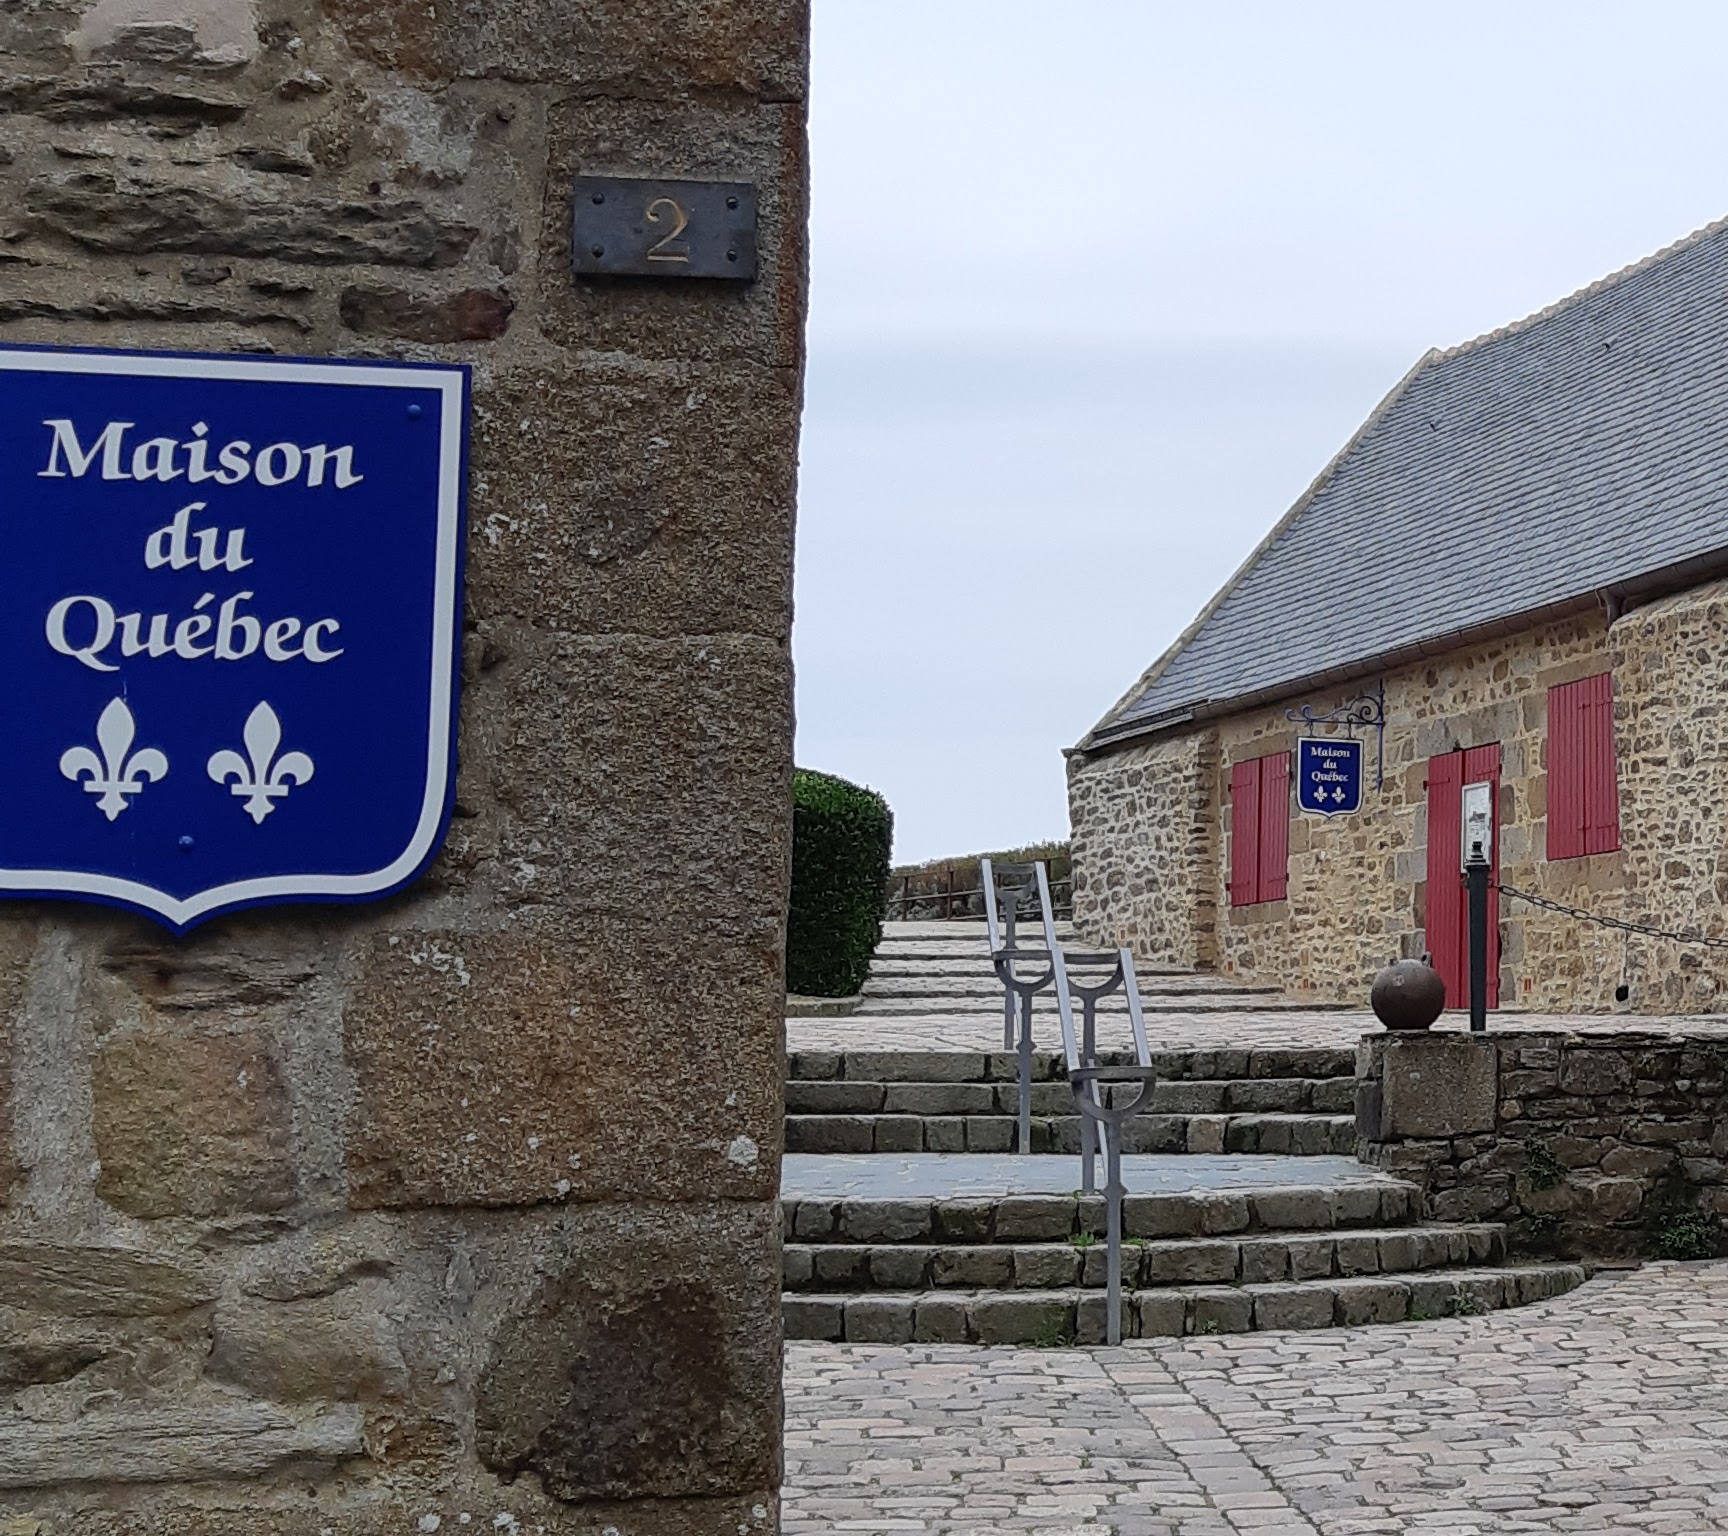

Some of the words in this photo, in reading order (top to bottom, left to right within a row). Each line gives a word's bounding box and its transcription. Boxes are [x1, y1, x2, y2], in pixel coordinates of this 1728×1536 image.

[646, 195, 690, 263] 2
[37, 419, 364, 489] Maison
[144, 502, 254, 571] du
[45, 591, 345, 671] Québec
[1311, 746, 1350, 757] Maison
[1323, 758, 1337, 769] du
